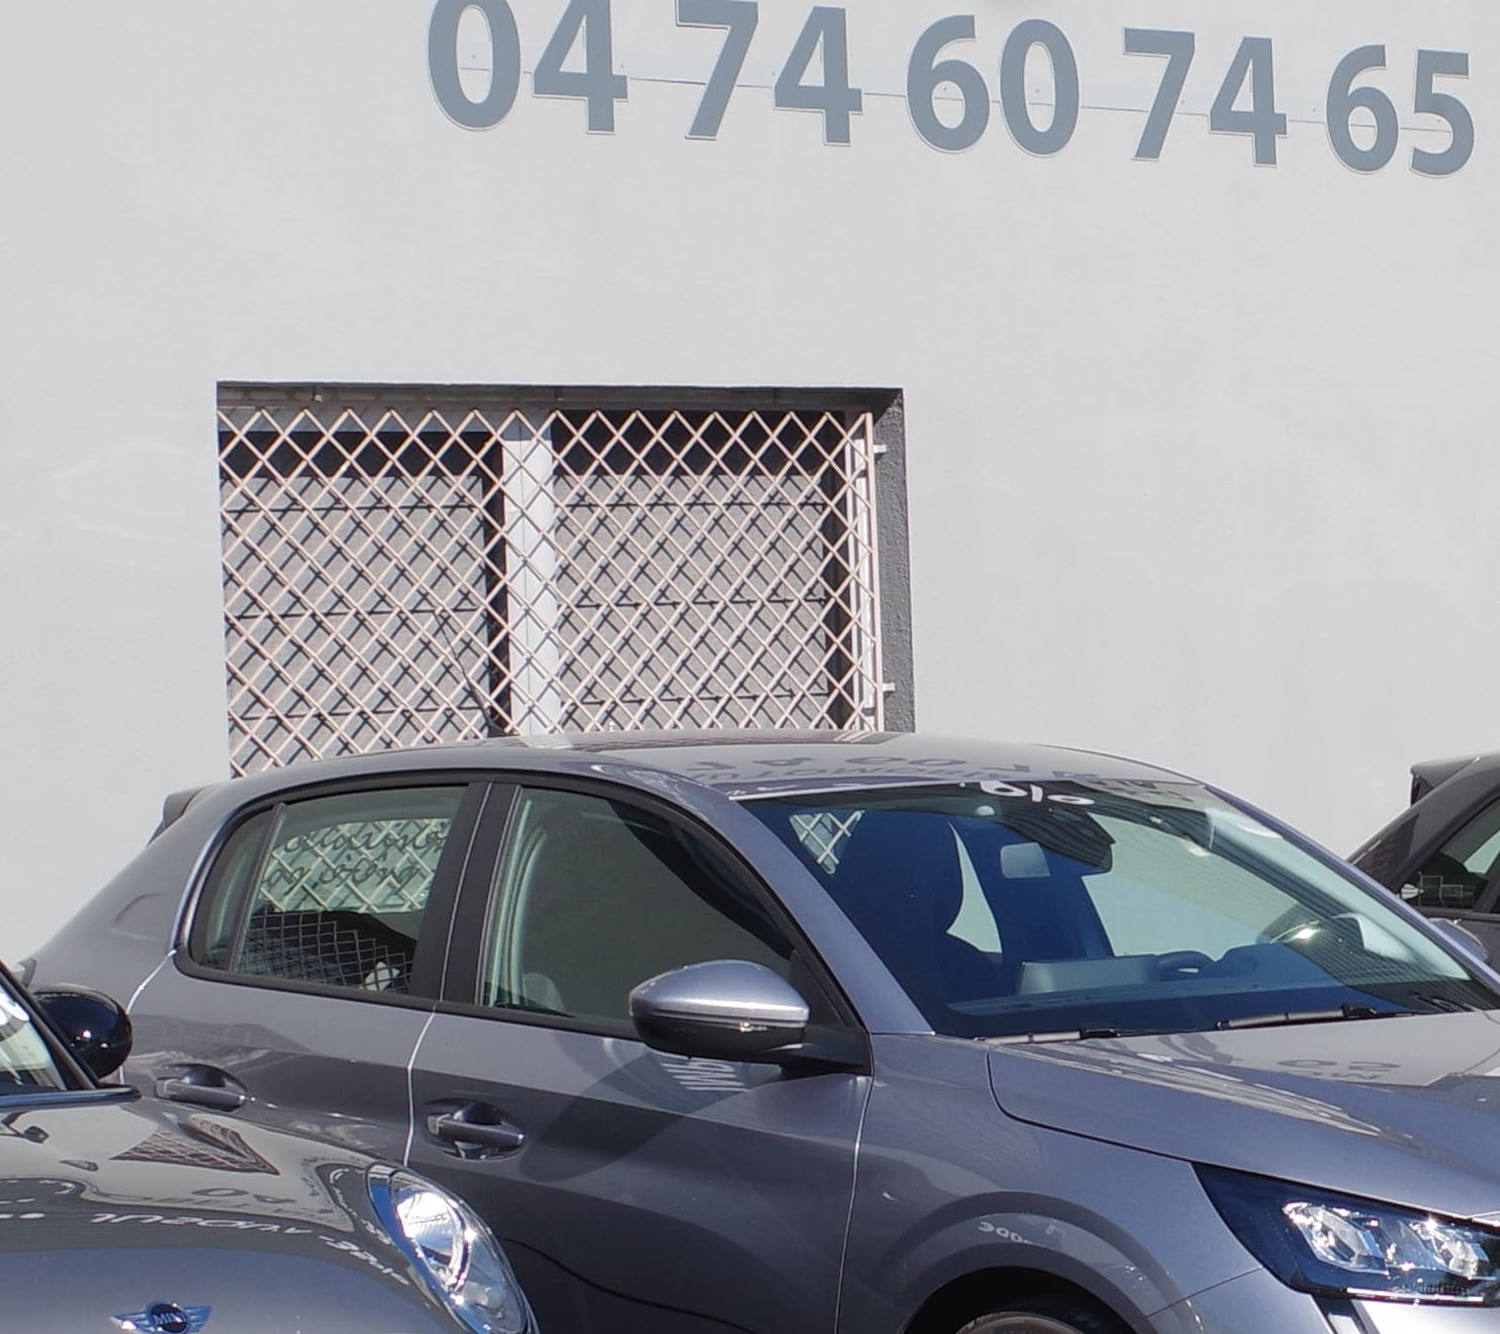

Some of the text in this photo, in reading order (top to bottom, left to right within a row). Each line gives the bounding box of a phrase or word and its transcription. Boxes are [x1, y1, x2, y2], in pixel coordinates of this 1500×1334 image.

[907, 15, 1080, 157] 60
[1123, 29, 1287, 166] 74
[1327, 44, 1475, 178] 65
[152, 1312, 187, 1325] MINI
